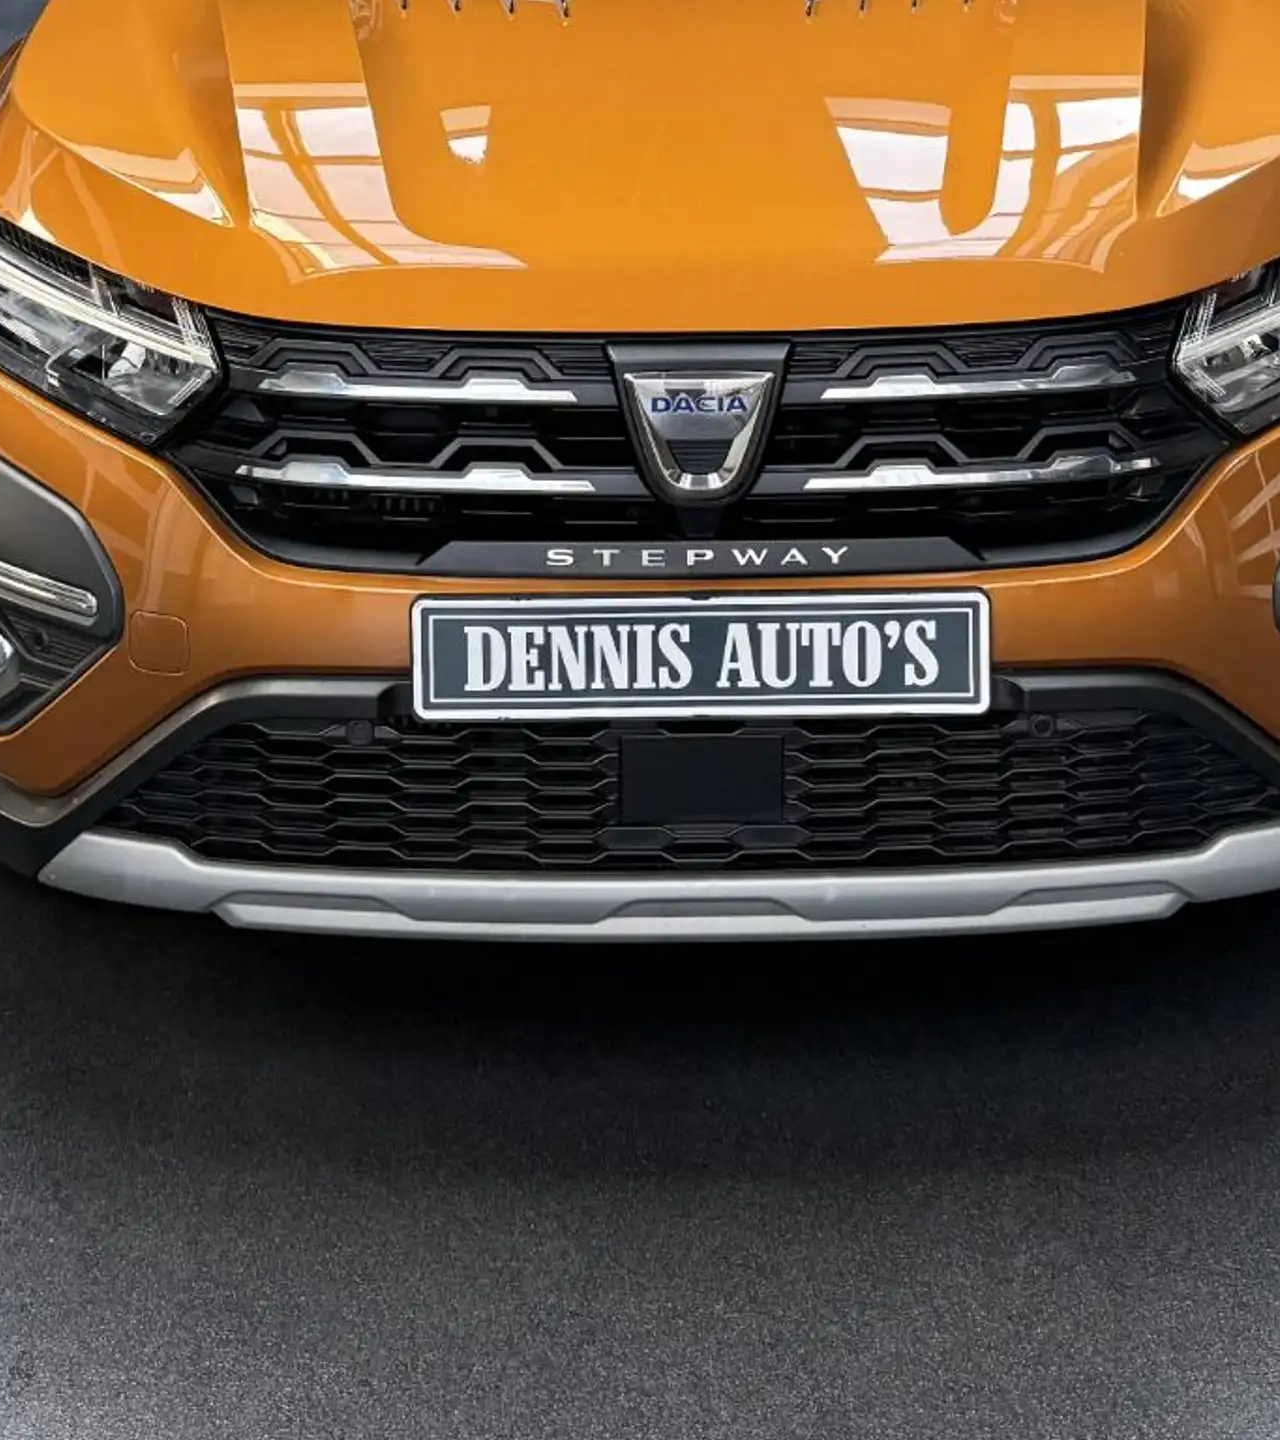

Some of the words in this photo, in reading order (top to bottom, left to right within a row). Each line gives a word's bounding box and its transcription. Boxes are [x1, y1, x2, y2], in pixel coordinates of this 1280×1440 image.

[650, 396, 749, 413] DACIA
[546, 546, 849, 566] STEPWAY
[463, 621, 693, 692] DENNIS
[716, 619, 939, 688] AUTO'S
